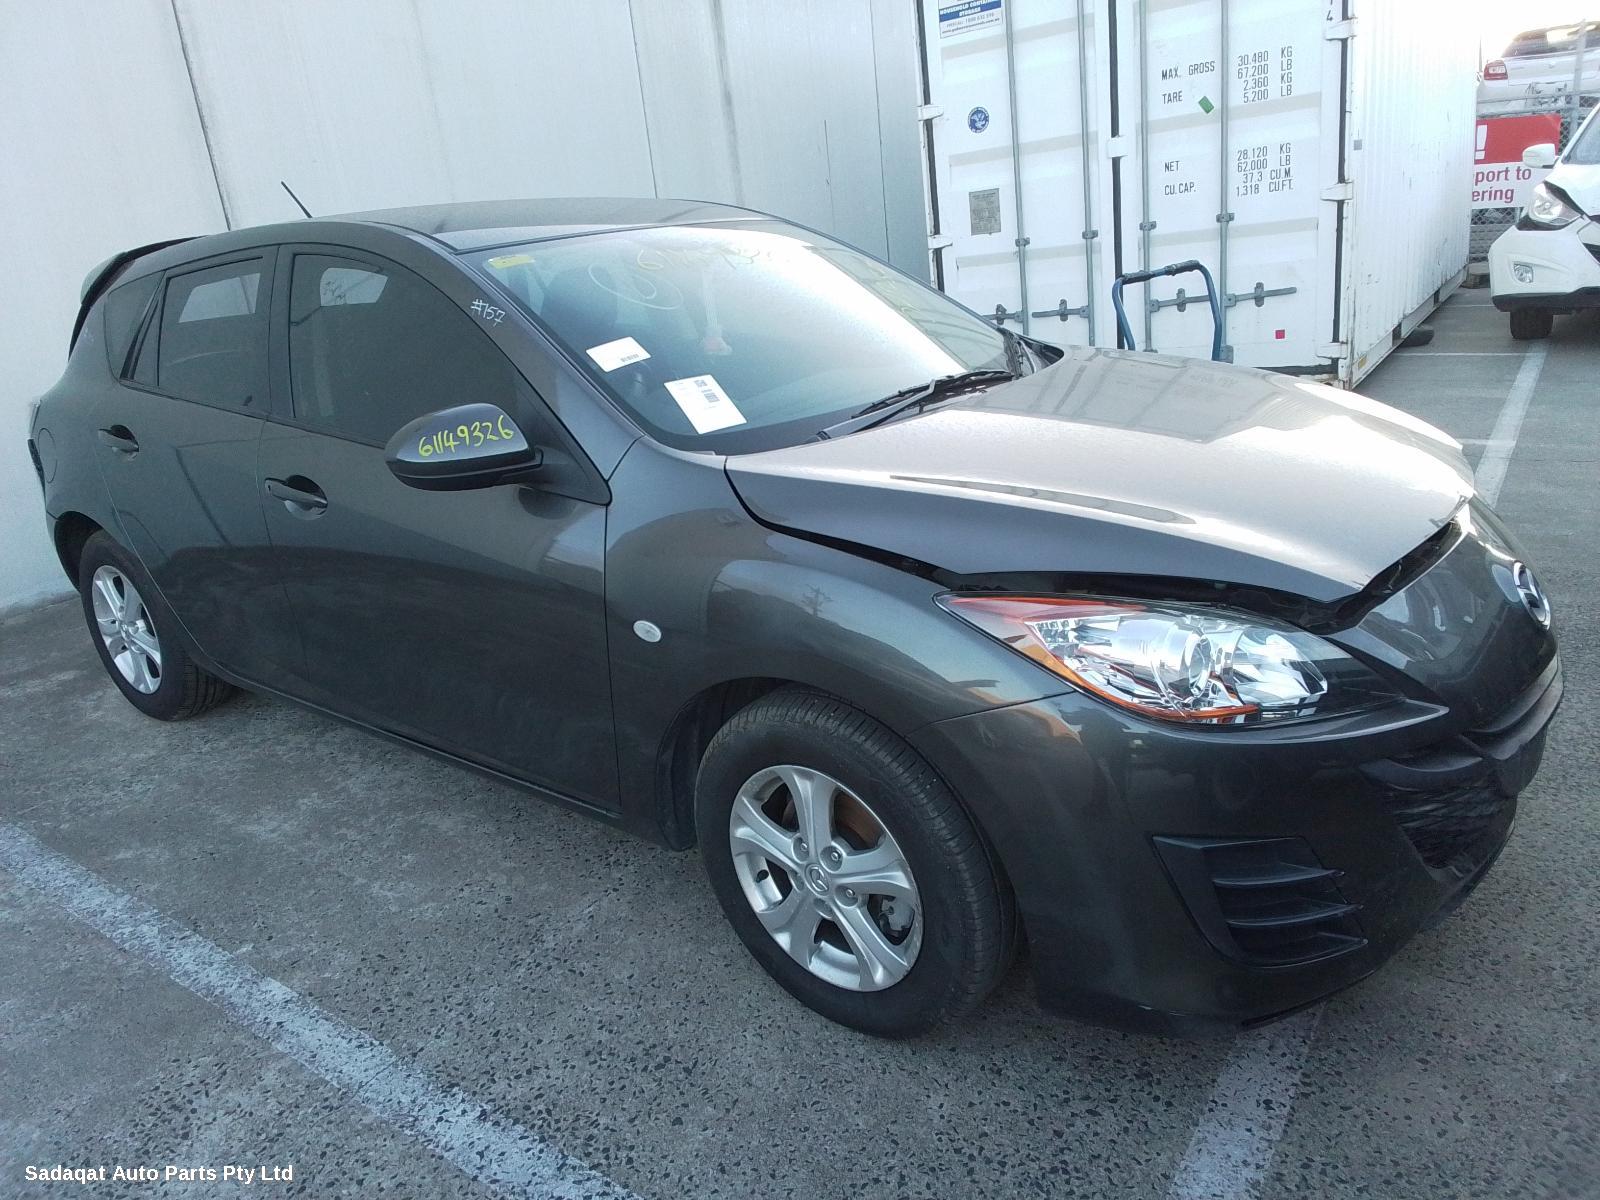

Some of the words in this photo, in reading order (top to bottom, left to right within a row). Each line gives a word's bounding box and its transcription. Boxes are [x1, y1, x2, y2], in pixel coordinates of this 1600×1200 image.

[1161, 66, 1181, 81] MAX.
[1188, 61, 1215, 75] GROSS
[1237, 50, 1269, 67] 30.480
[1280, 46, 1293, 59] KG
[1237, 63, 1269, 80] 67.200
[1280, 58, 1292, 72] LB
[1162, 90, 1183, 105] TARE
[1243, 76, 1269, 92] 2.360
[1280, 72, 1293, 85] KG
[1243, 88, 1269, 104] 5.200
[1280, 84, 1292, 97] LB
[1164, 160, 1180, 173] NET
[1237, 145, 1268, 161] 28.120
[1279, 142, 1291, 154] KG
[1279, 154, 1291, 167] LB
[1243, 171, 1263, 184] 37.3
[1474, 166, 1510, 186] port
[1516, 166, 1532, 181] to
[1471, 186, 1515, 204] ering
[470, 299, 506, 327] #157
[418, 415, 515, 457] 61149326
